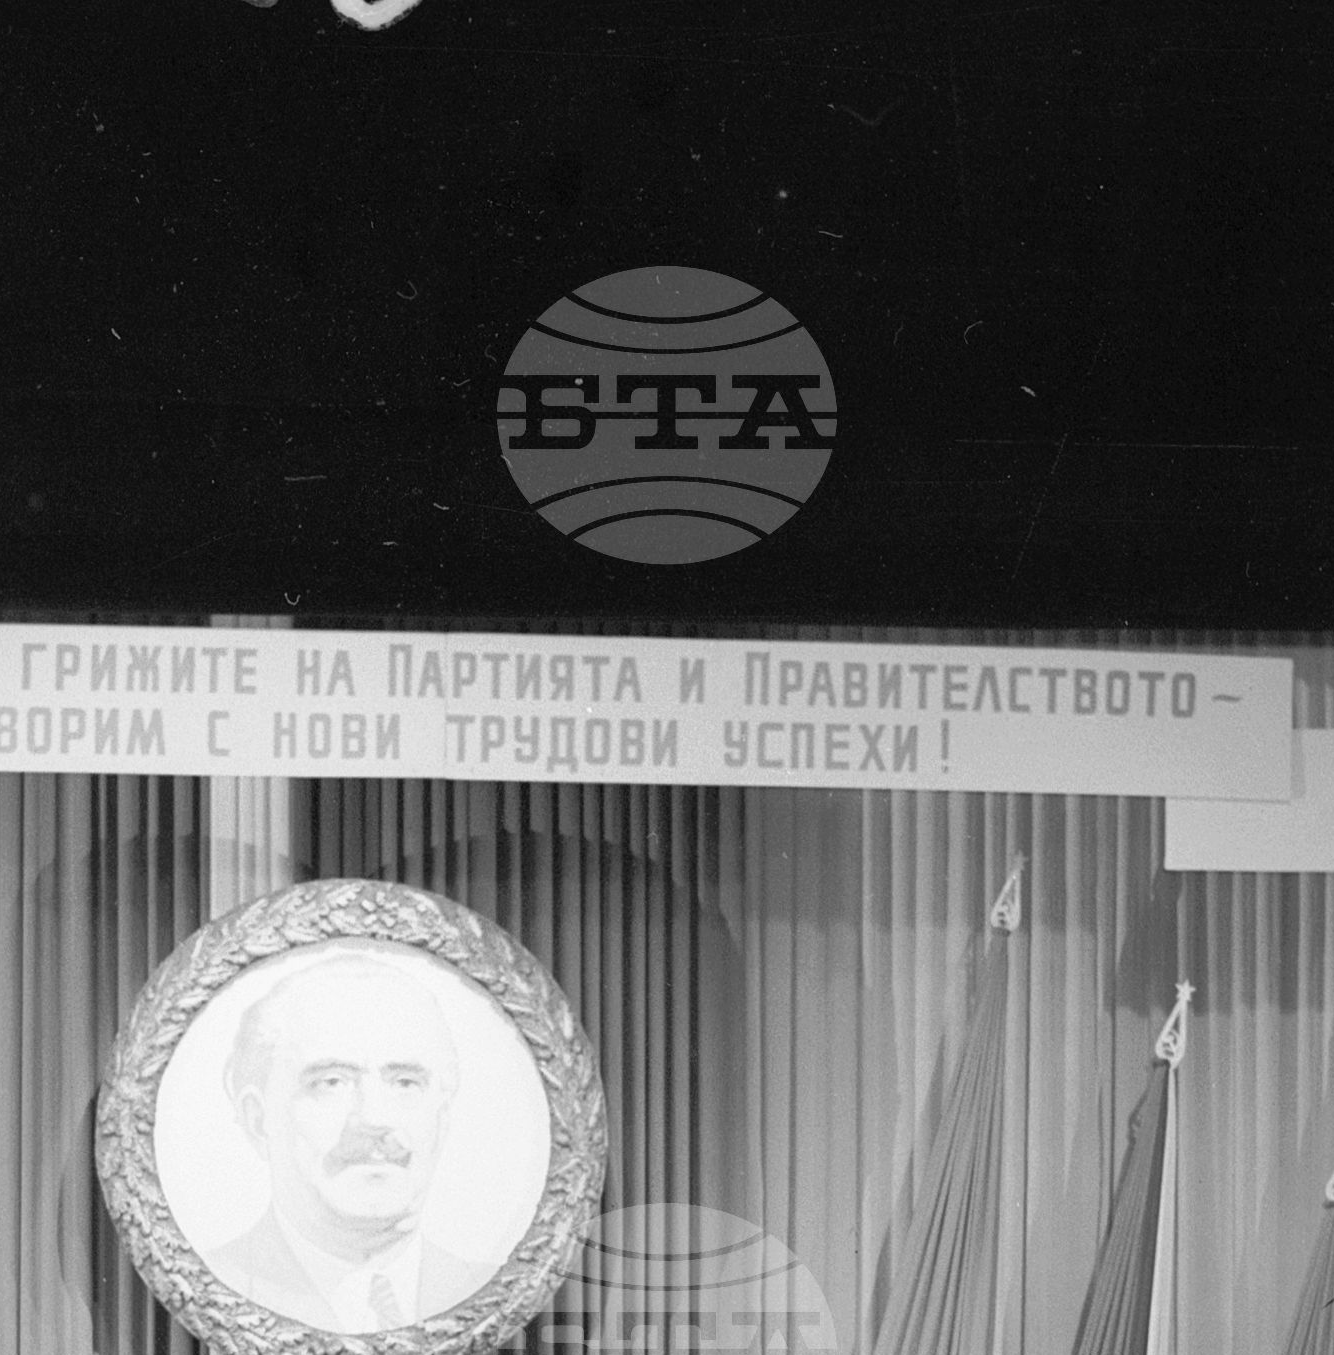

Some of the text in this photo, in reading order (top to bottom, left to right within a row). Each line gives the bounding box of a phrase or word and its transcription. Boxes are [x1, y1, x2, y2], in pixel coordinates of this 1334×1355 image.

[21, 642, 258, 696] ГРИЖИТЕ
[296, 648, 356, 699] НА
[387, 643, 643, 705] ПАРТИЯТА
[679, 657, 706, 705] И
[206, 709, 230, 757] С
[274, 711, 402, 761] НОВИ
[446, 714, 679, 773] ТРУДОВИ
